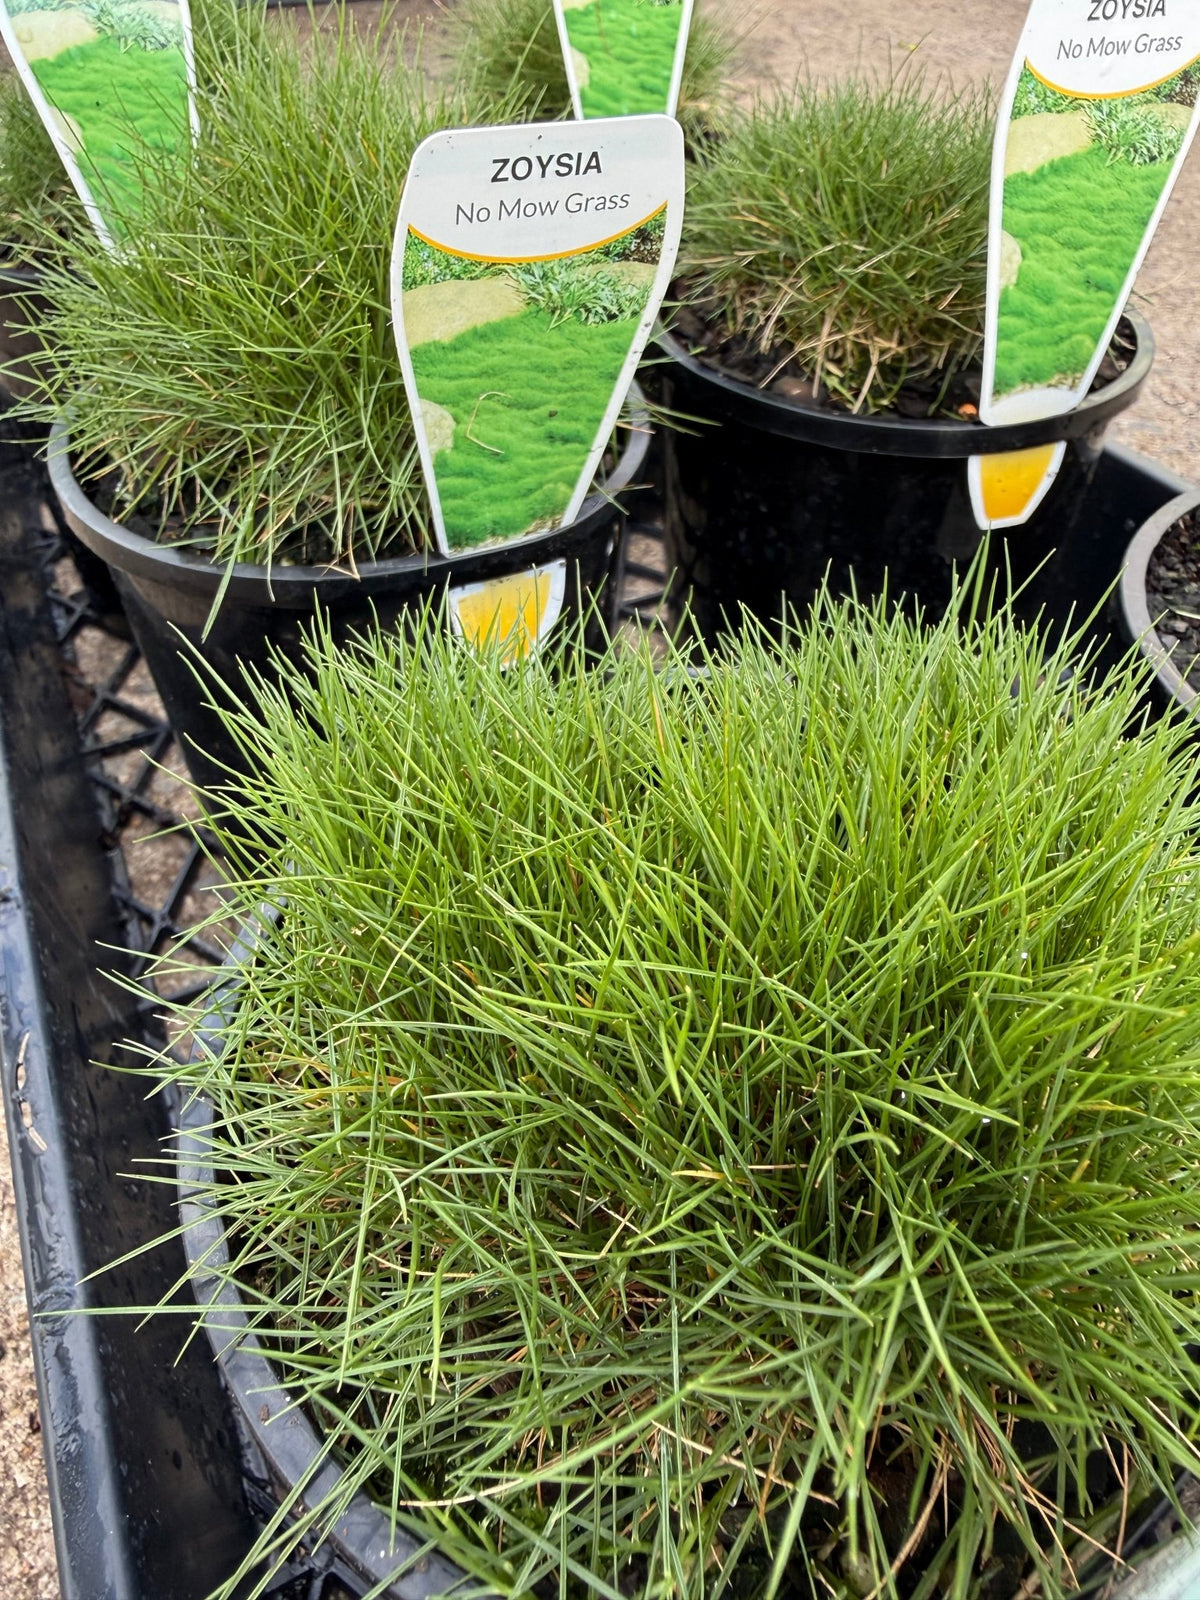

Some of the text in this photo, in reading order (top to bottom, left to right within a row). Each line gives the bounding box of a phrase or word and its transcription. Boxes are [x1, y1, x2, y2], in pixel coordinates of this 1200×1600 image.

[1087, 0, 1166, 21] ZOYSIA
[1056, 33, 1183, 60] No Mow Grass
[491, 151, 602, 183] ZOYSIA
[455, 192, 630, 225] No Mow Grass
